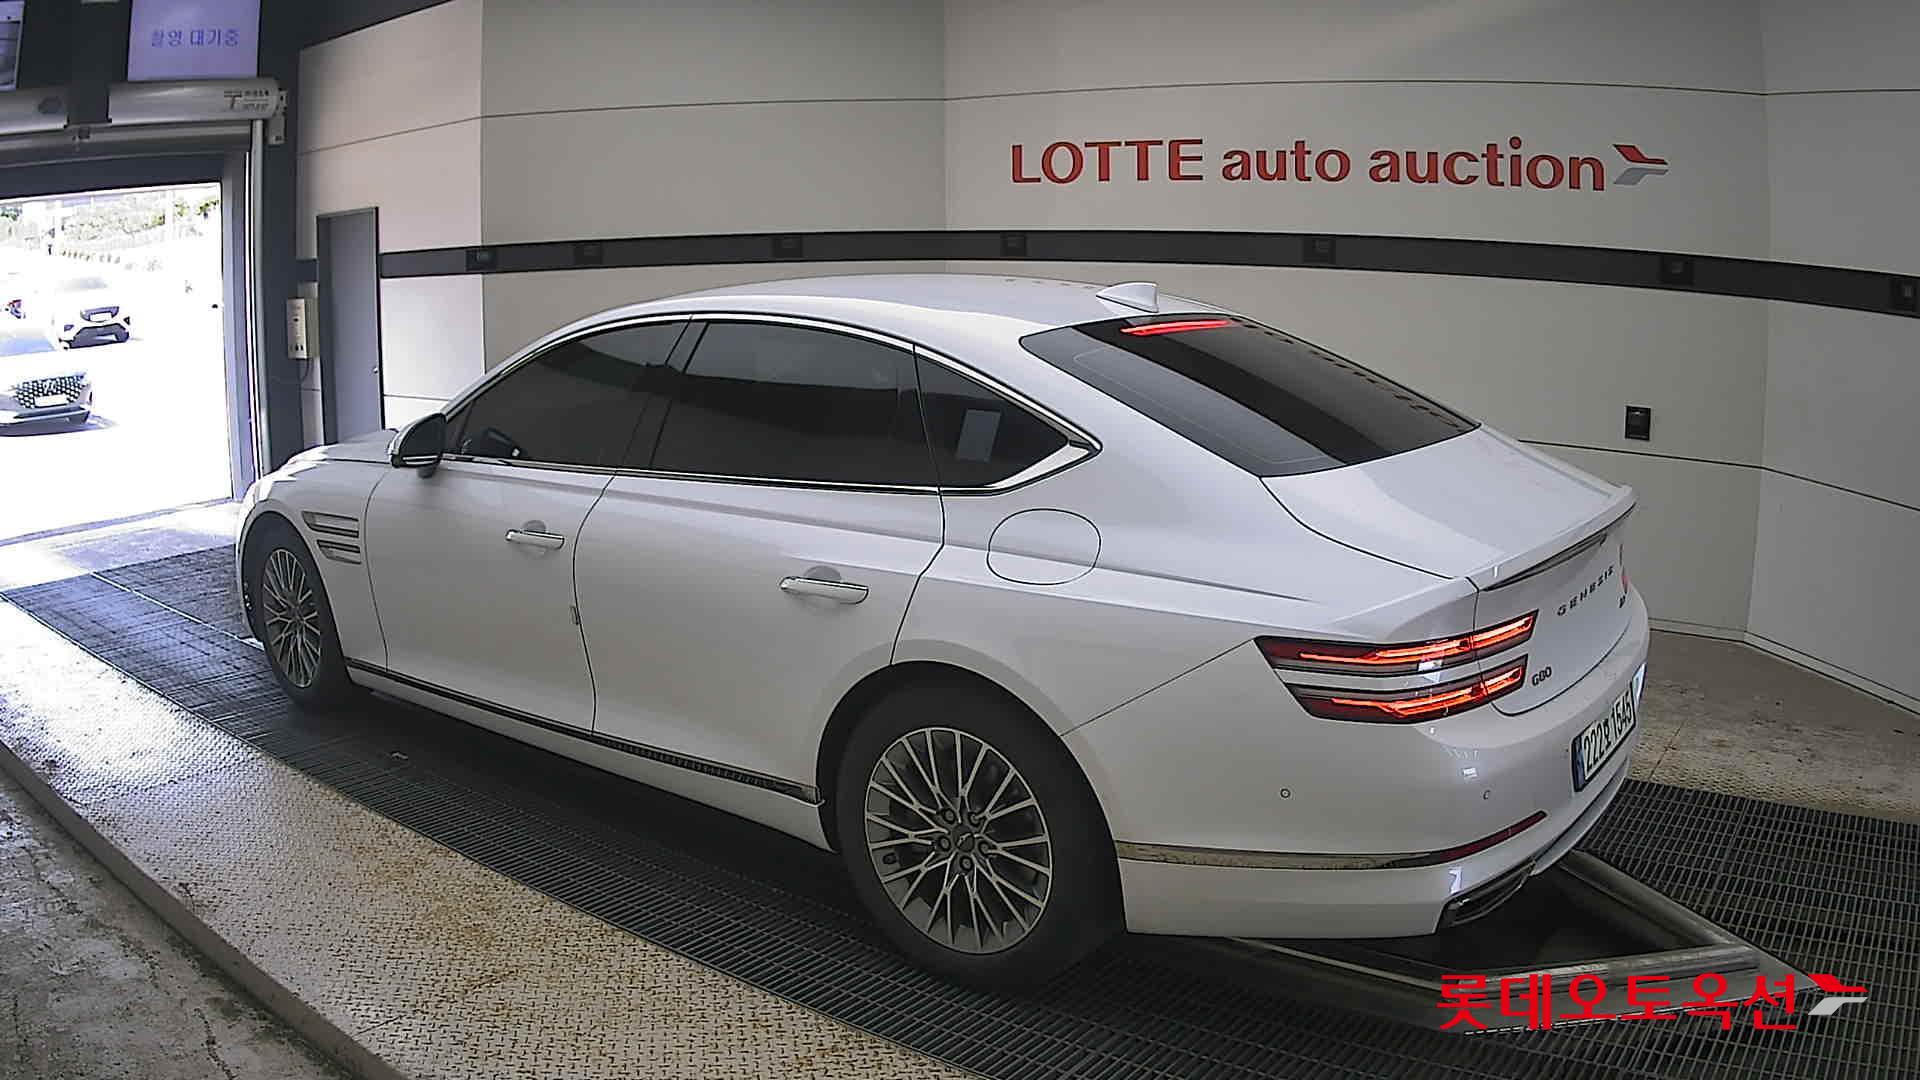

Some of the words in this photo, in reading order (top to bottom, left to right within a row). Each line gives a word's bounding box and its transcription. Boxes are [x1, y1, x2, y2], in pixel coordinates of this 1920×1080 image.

[190, 28, 240, 47] 대기중
[1011, 139, 1204, 185] LOTTE
[1222, 140, 1351, 182] auto
[1369, 136, 1605, 192] auction
[1556, 564, 1615, 617] GENESIS
[1531, 665, 1553, 687] G80
